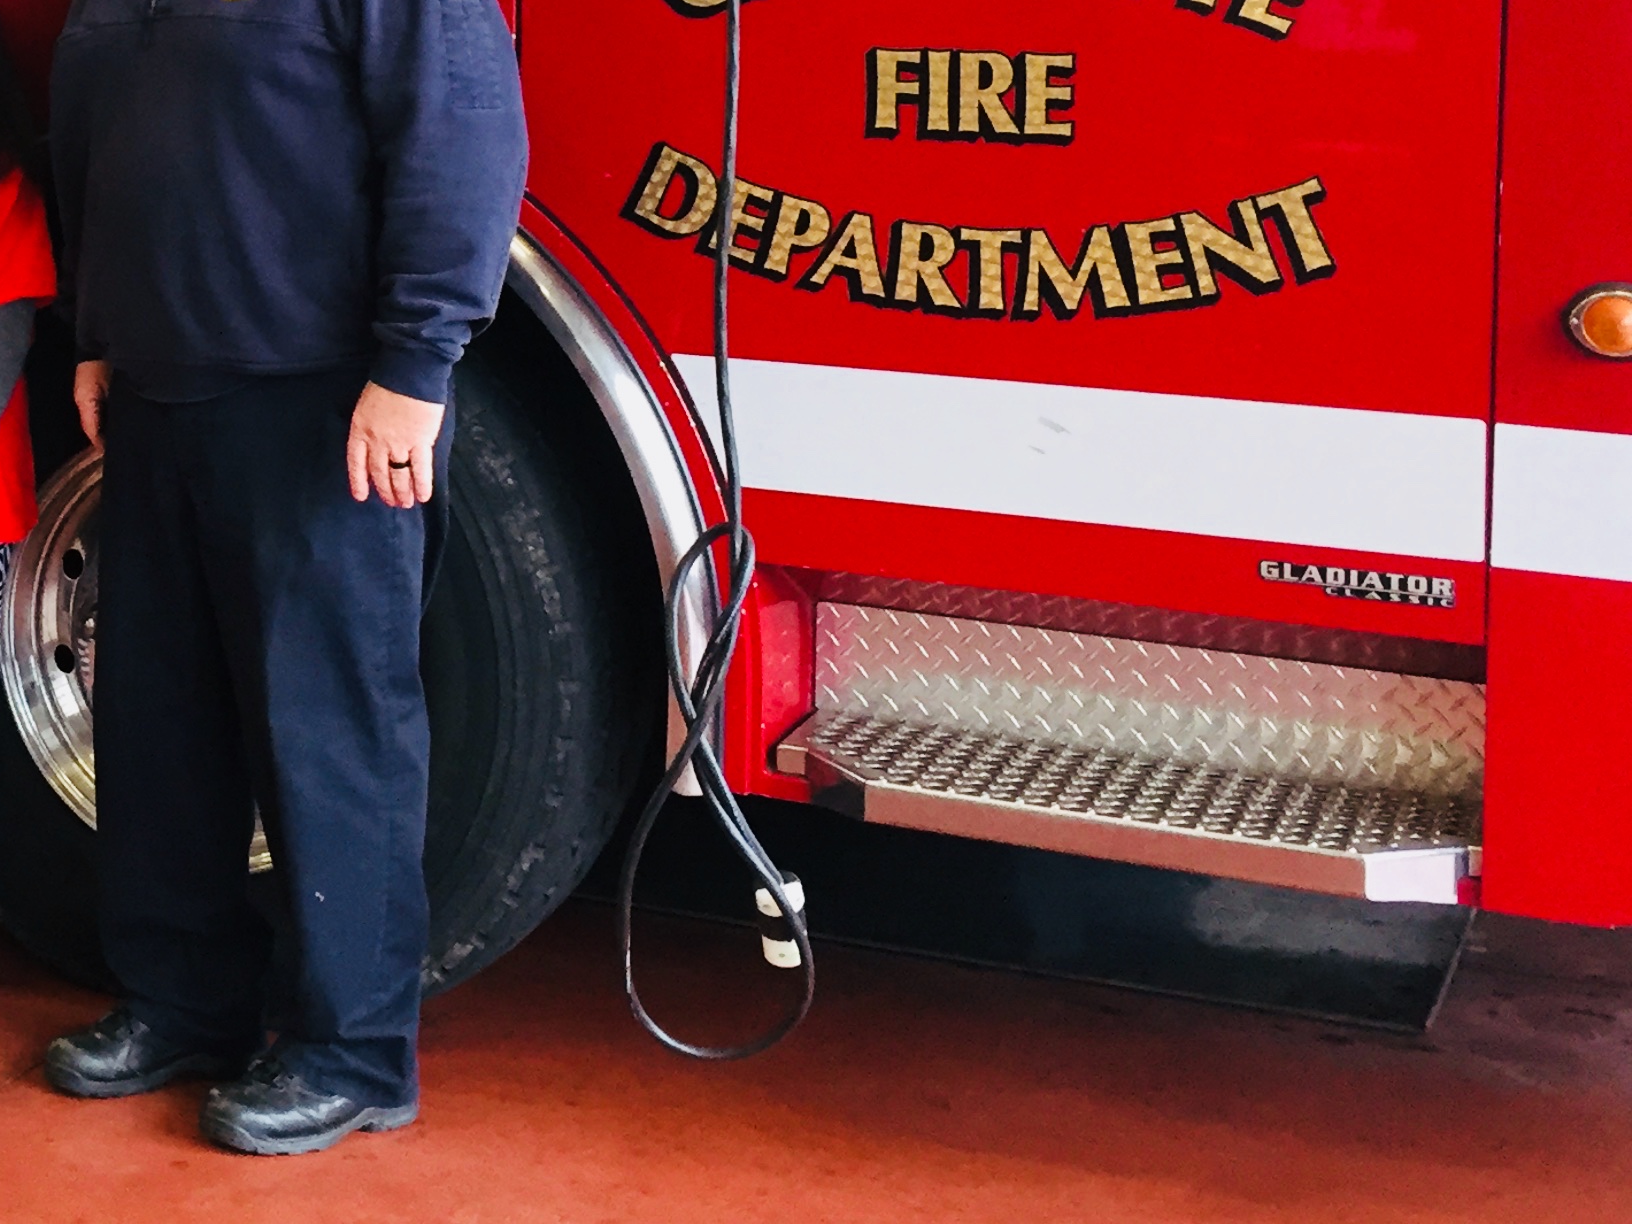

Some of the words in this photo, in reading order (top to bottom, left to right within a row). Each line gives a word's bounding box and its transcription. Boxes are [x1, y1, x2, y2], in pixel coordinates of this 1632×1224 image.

[864, 48, 1076, 144] FIRE
[621, 142, 1337, 319] DEPARTMENT
[1259, 560, 1453, 597] GLADIATOR
[1325, 587, 1455, 608] CLASSIC
